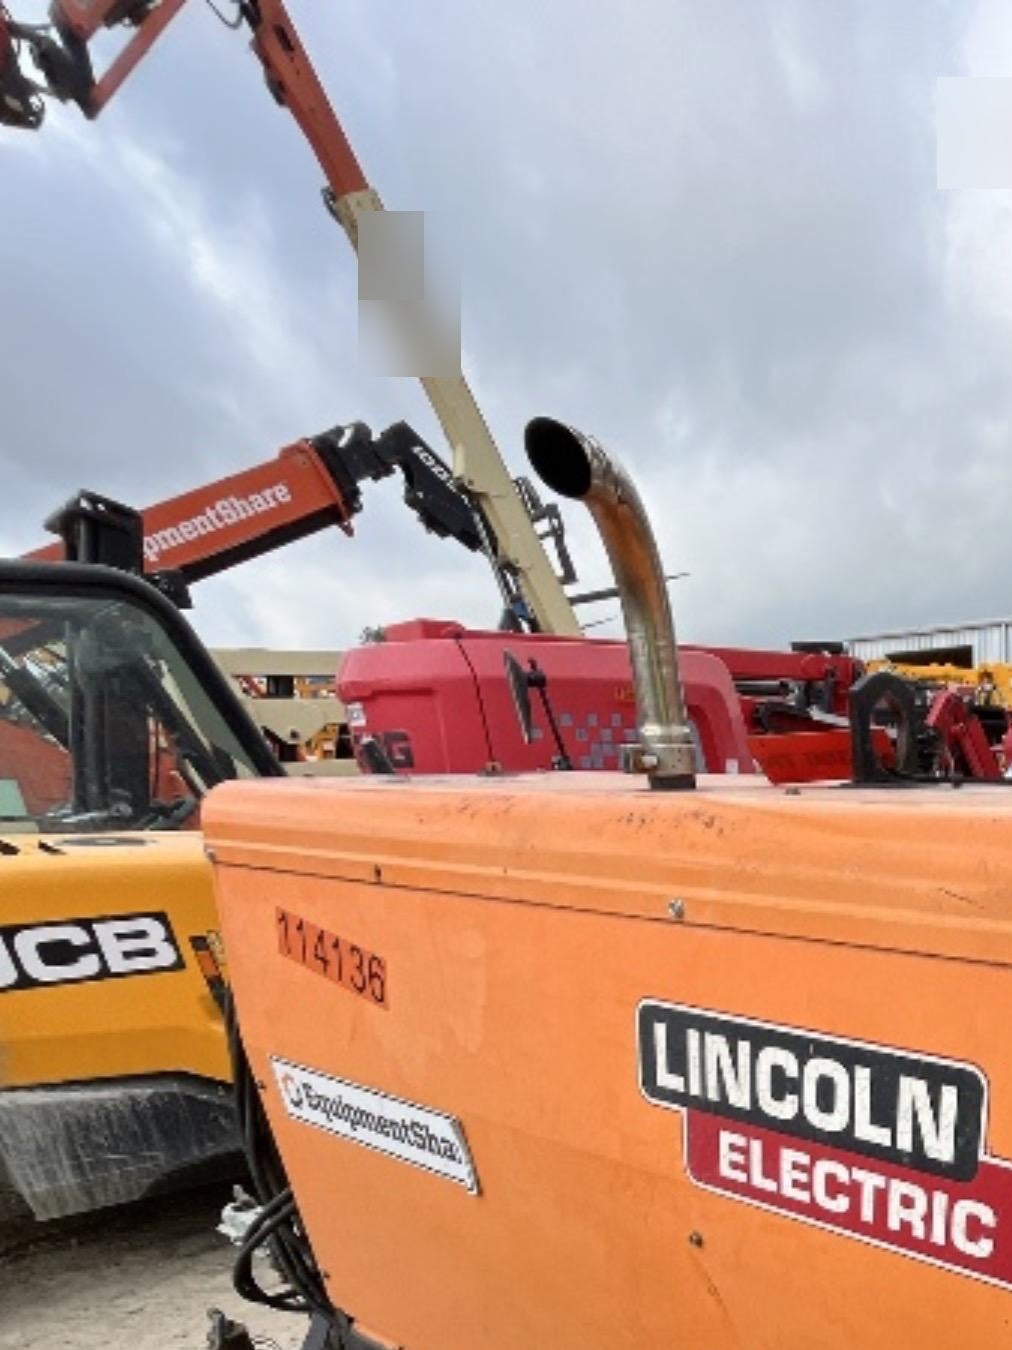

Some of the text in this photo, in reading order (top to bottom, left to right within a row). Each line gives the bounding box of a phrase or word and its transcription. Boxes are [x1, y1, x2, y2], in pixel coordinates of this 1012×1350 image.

[143, 481, 292, 562] pmentShare
[278, 911, 385, 1003] 114136
[652, 1020, 959, 1164] LINCOLN
[717, 1129, 997, 1260] ELECTRIC
